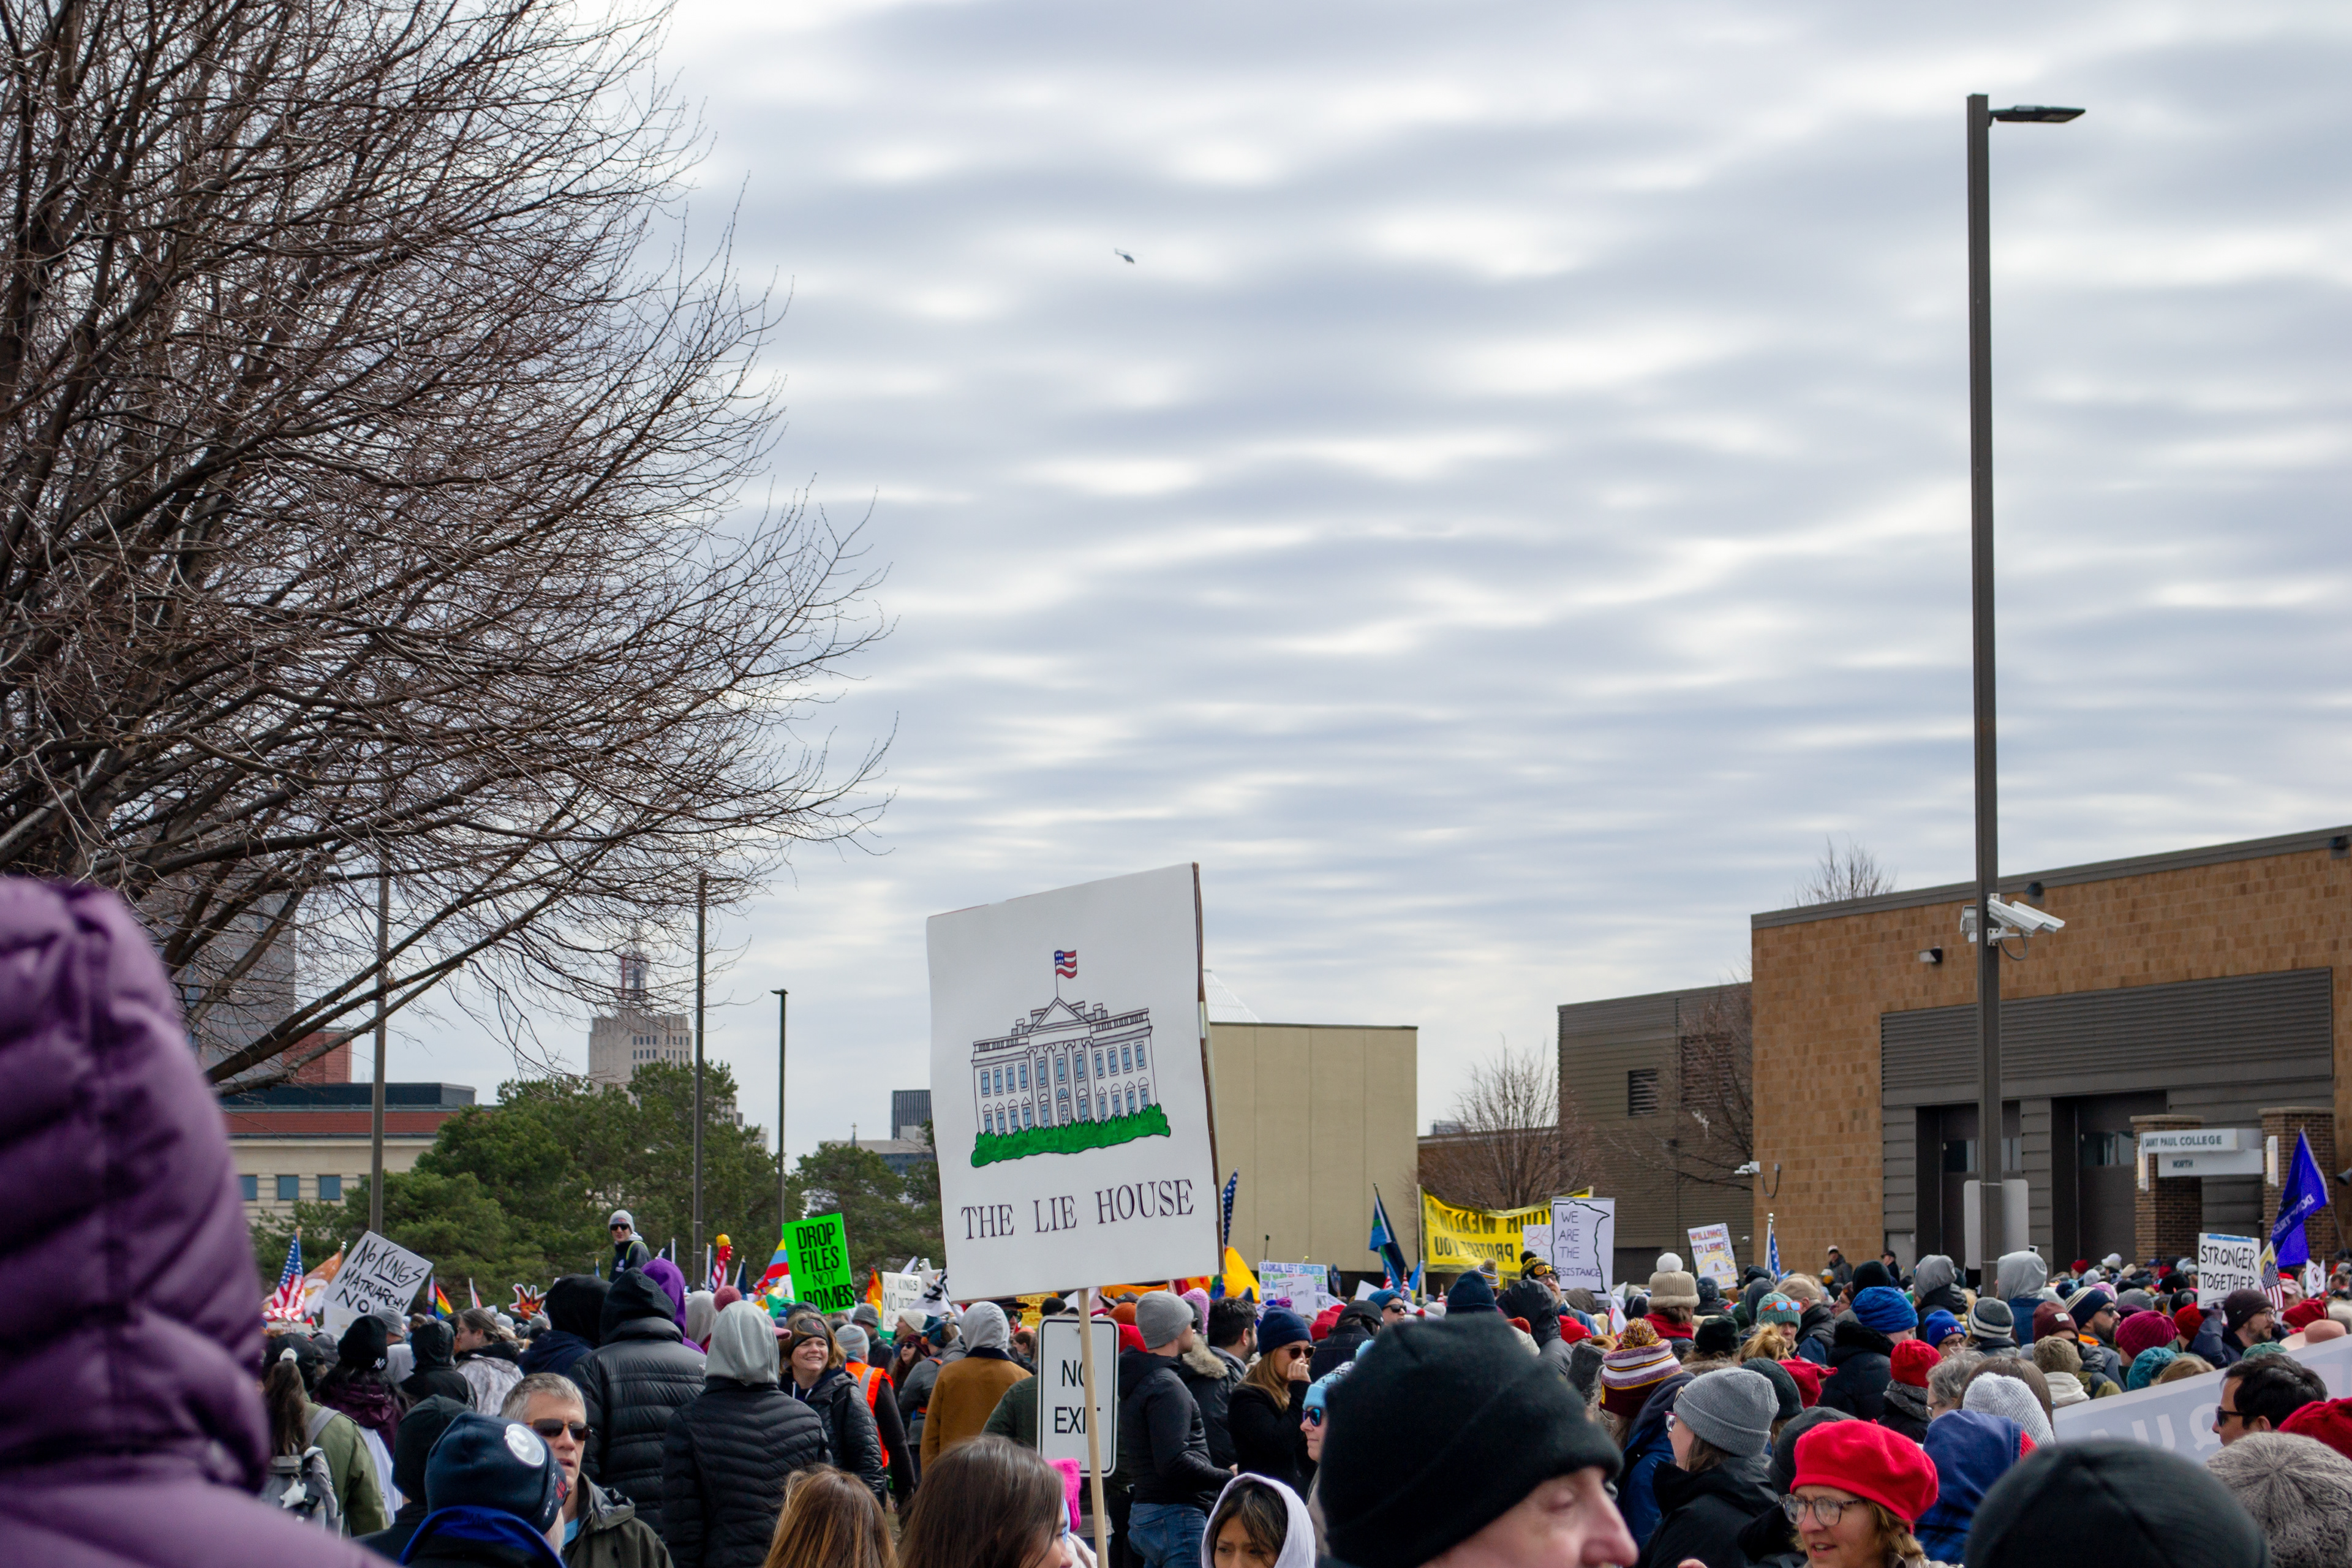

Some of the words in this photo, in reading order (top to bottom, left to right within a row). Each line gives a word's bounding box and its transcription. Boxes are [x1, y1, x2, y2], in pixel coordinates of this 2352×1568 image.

[2146, 1137, 2158, 1147] SAINT
[2160, 1137, 2177, 1147] PAUL
[2180, 1135, 2222, 1146] COLLEGE
[2173, 1159, 2194, 1169] NORTH
[961, 1204, 1014, 1240] THE
[1033, 1195, 1077, 1233] LIE
[1095, 1179, 1194, 1225] HOUSE
[1561, 1211, 1578, 1223] WE
[796, 1222, 835, 1250] DROP
[1527, 1227, 1551, 1246] 86
[1558, 1229, 1580, 1242] ARE
[1689, 1228, 1722, 1241] WILLING
[1559, 1246, 1580, 1259] THE
[1692, 1245, 1703, 1254] TO
[2200, 1244, 2256, 1272] STRONGER
[369, 1246, 424, 1287] KINGS
[801, 1246, 839, 1274] FILES
[1285, 1264, 1298, 1273] LEFT
[1714, 1262, 1721, 1272] A
[812, 1270, 837, 1287] NOT
[1553, 1266, 1601, 1277] RESISTANCE
[339, 1267, 409, 1311] MATRIARCHY
[898, 1278, 918, 1291] KINGS
[2200, 1272, 2255, 1291] TOGETHER
[335, 1288, 379, 1314] NO
[803, 1284, 854, 1311] BOMBS
[884, 1291, 896, 1311] NO
[1055, 1407, 1101, 1434] EXI
